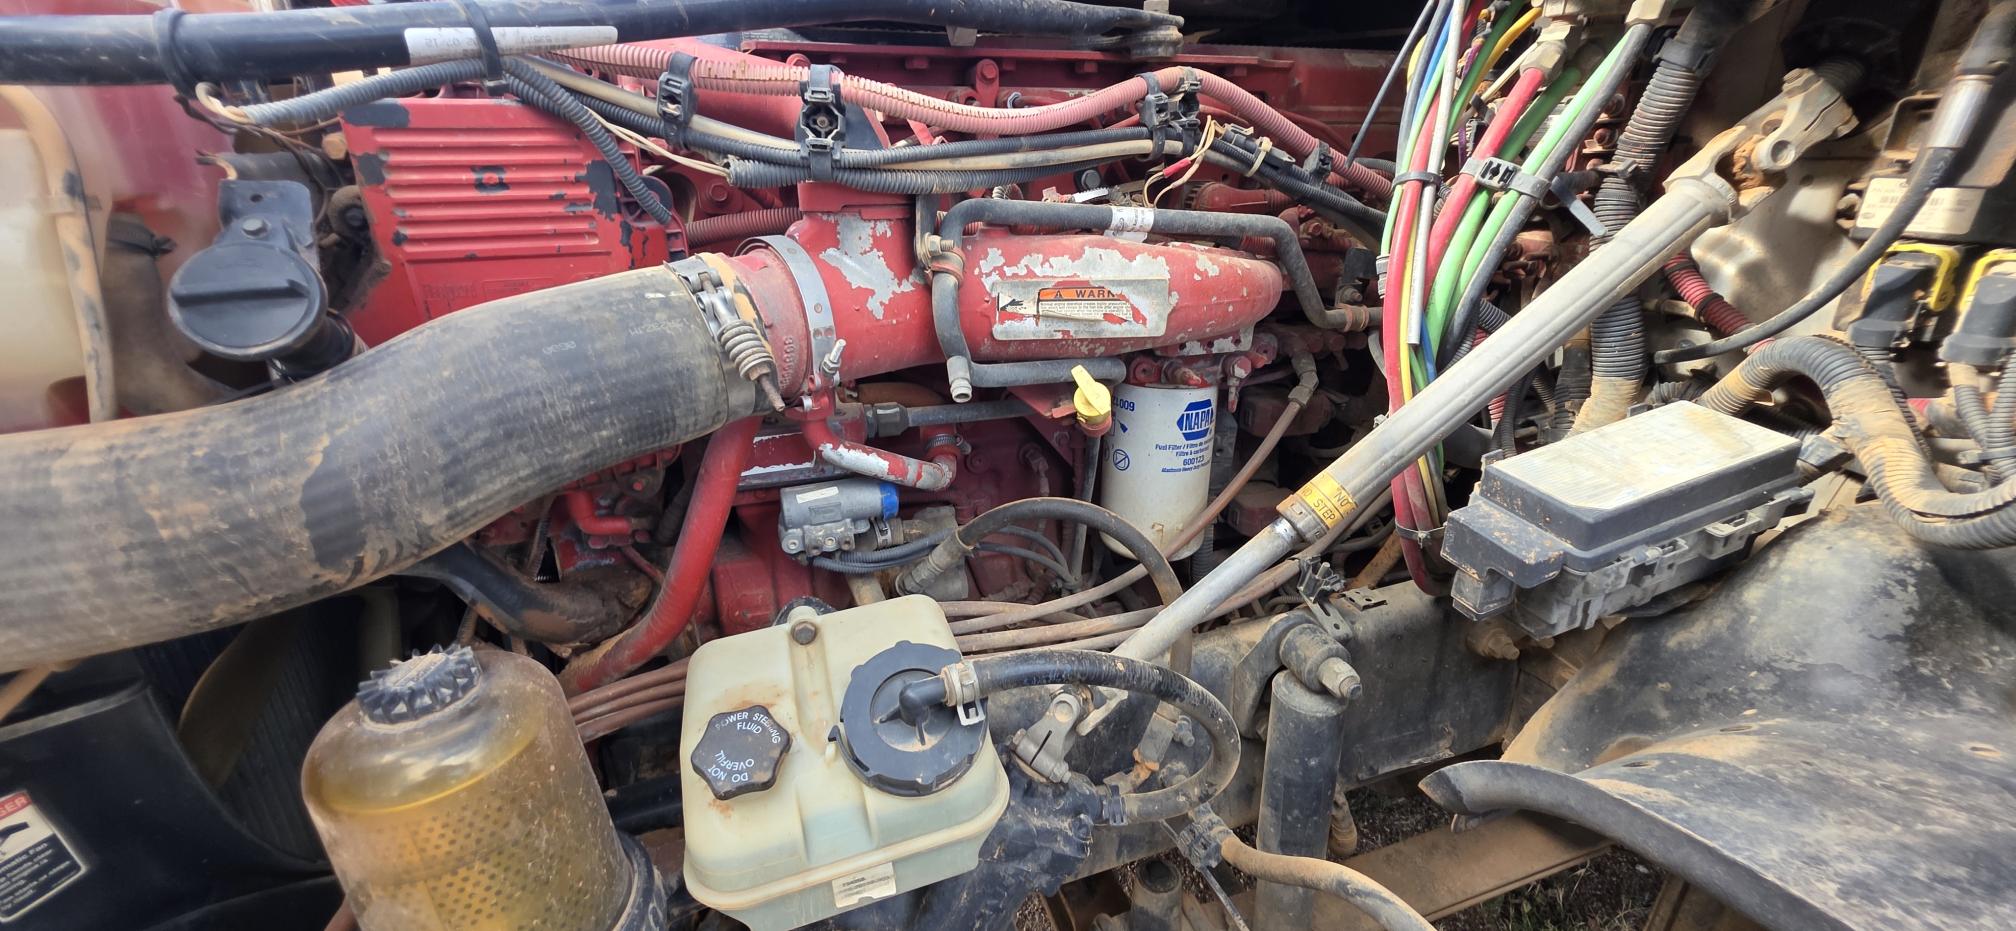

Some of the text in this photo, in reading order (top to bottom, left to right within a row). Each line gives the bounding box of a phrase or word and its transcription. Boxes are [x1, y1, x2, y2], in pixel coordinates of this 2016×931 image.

[1184, 408, 1210, 431] NAPA
[1183, 454, 1204, 466] 600123
[1334, 490, 1350, 508] NO
[1314, 498, 1336, 520] STEP
[715, 712, 748, 730] POWER
[737, 722, 762, 734] FLUID
[715, 750, 754, 770] OVERFILL
[708, 764, 748, 782] DO NOT
